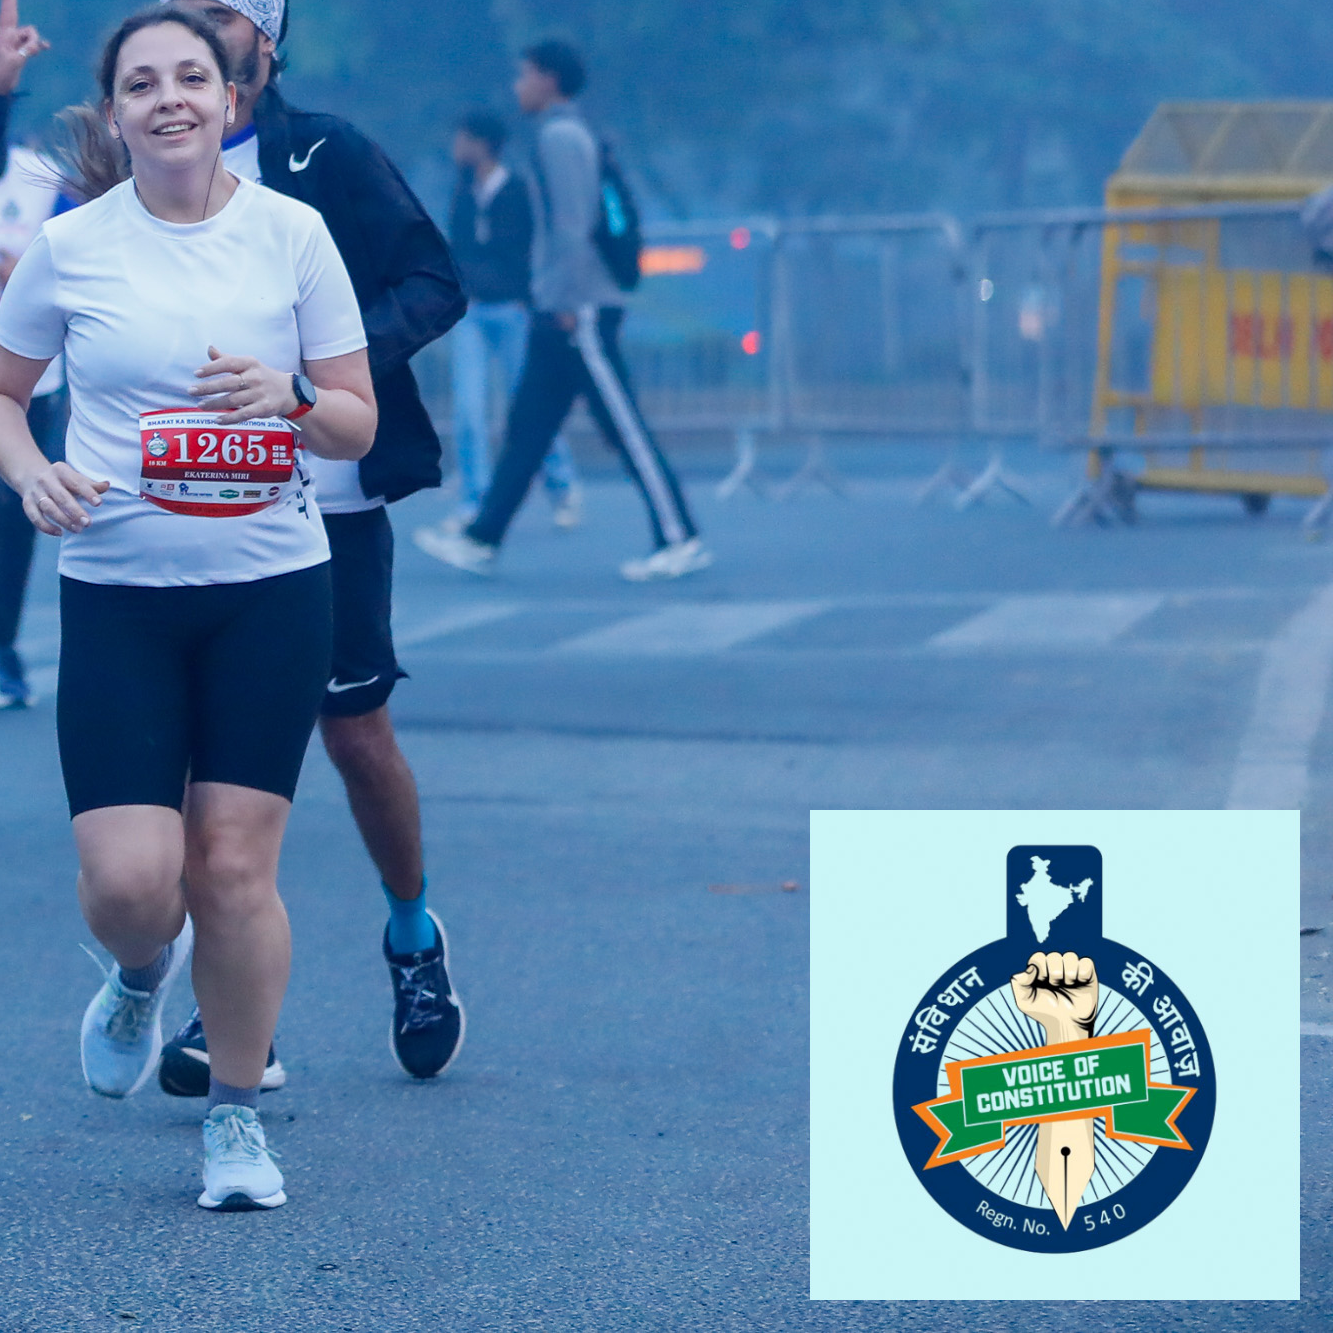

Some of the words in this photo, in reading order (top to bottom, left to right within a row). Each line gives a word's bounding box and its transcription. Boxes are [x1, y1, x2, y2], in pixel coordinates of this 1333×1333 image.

[173, 432, 268, 466] 1265
[184, 471, 230, 479] EKATERINA
[231, 472, 250, 480] MIRI
